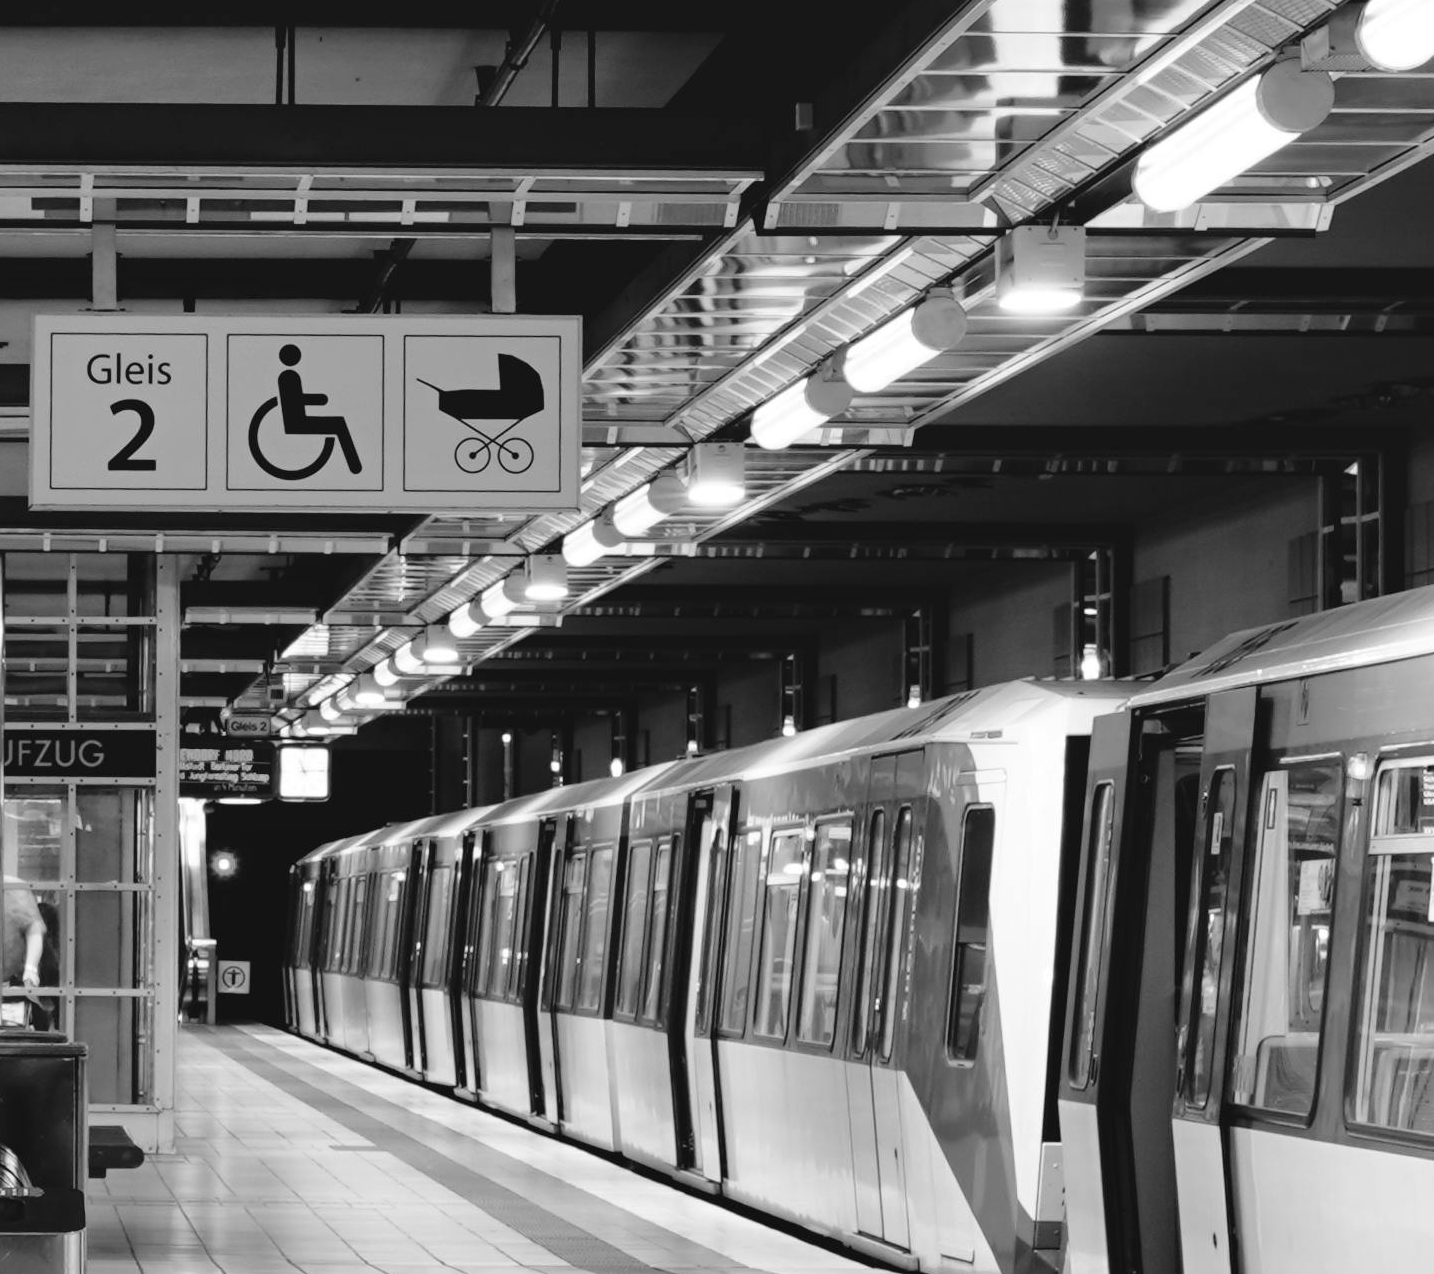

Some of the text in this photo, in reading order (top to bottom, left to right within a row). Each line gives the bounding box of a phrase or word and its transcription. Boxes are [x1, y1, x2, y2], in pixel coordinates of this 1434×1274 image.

[86, 352, 172, 385] Gleis
[107, 398, 157, 472] 2
[231, 720, 267, 732] Gleis 2
[179, 748, 221, 762] ENDORF
